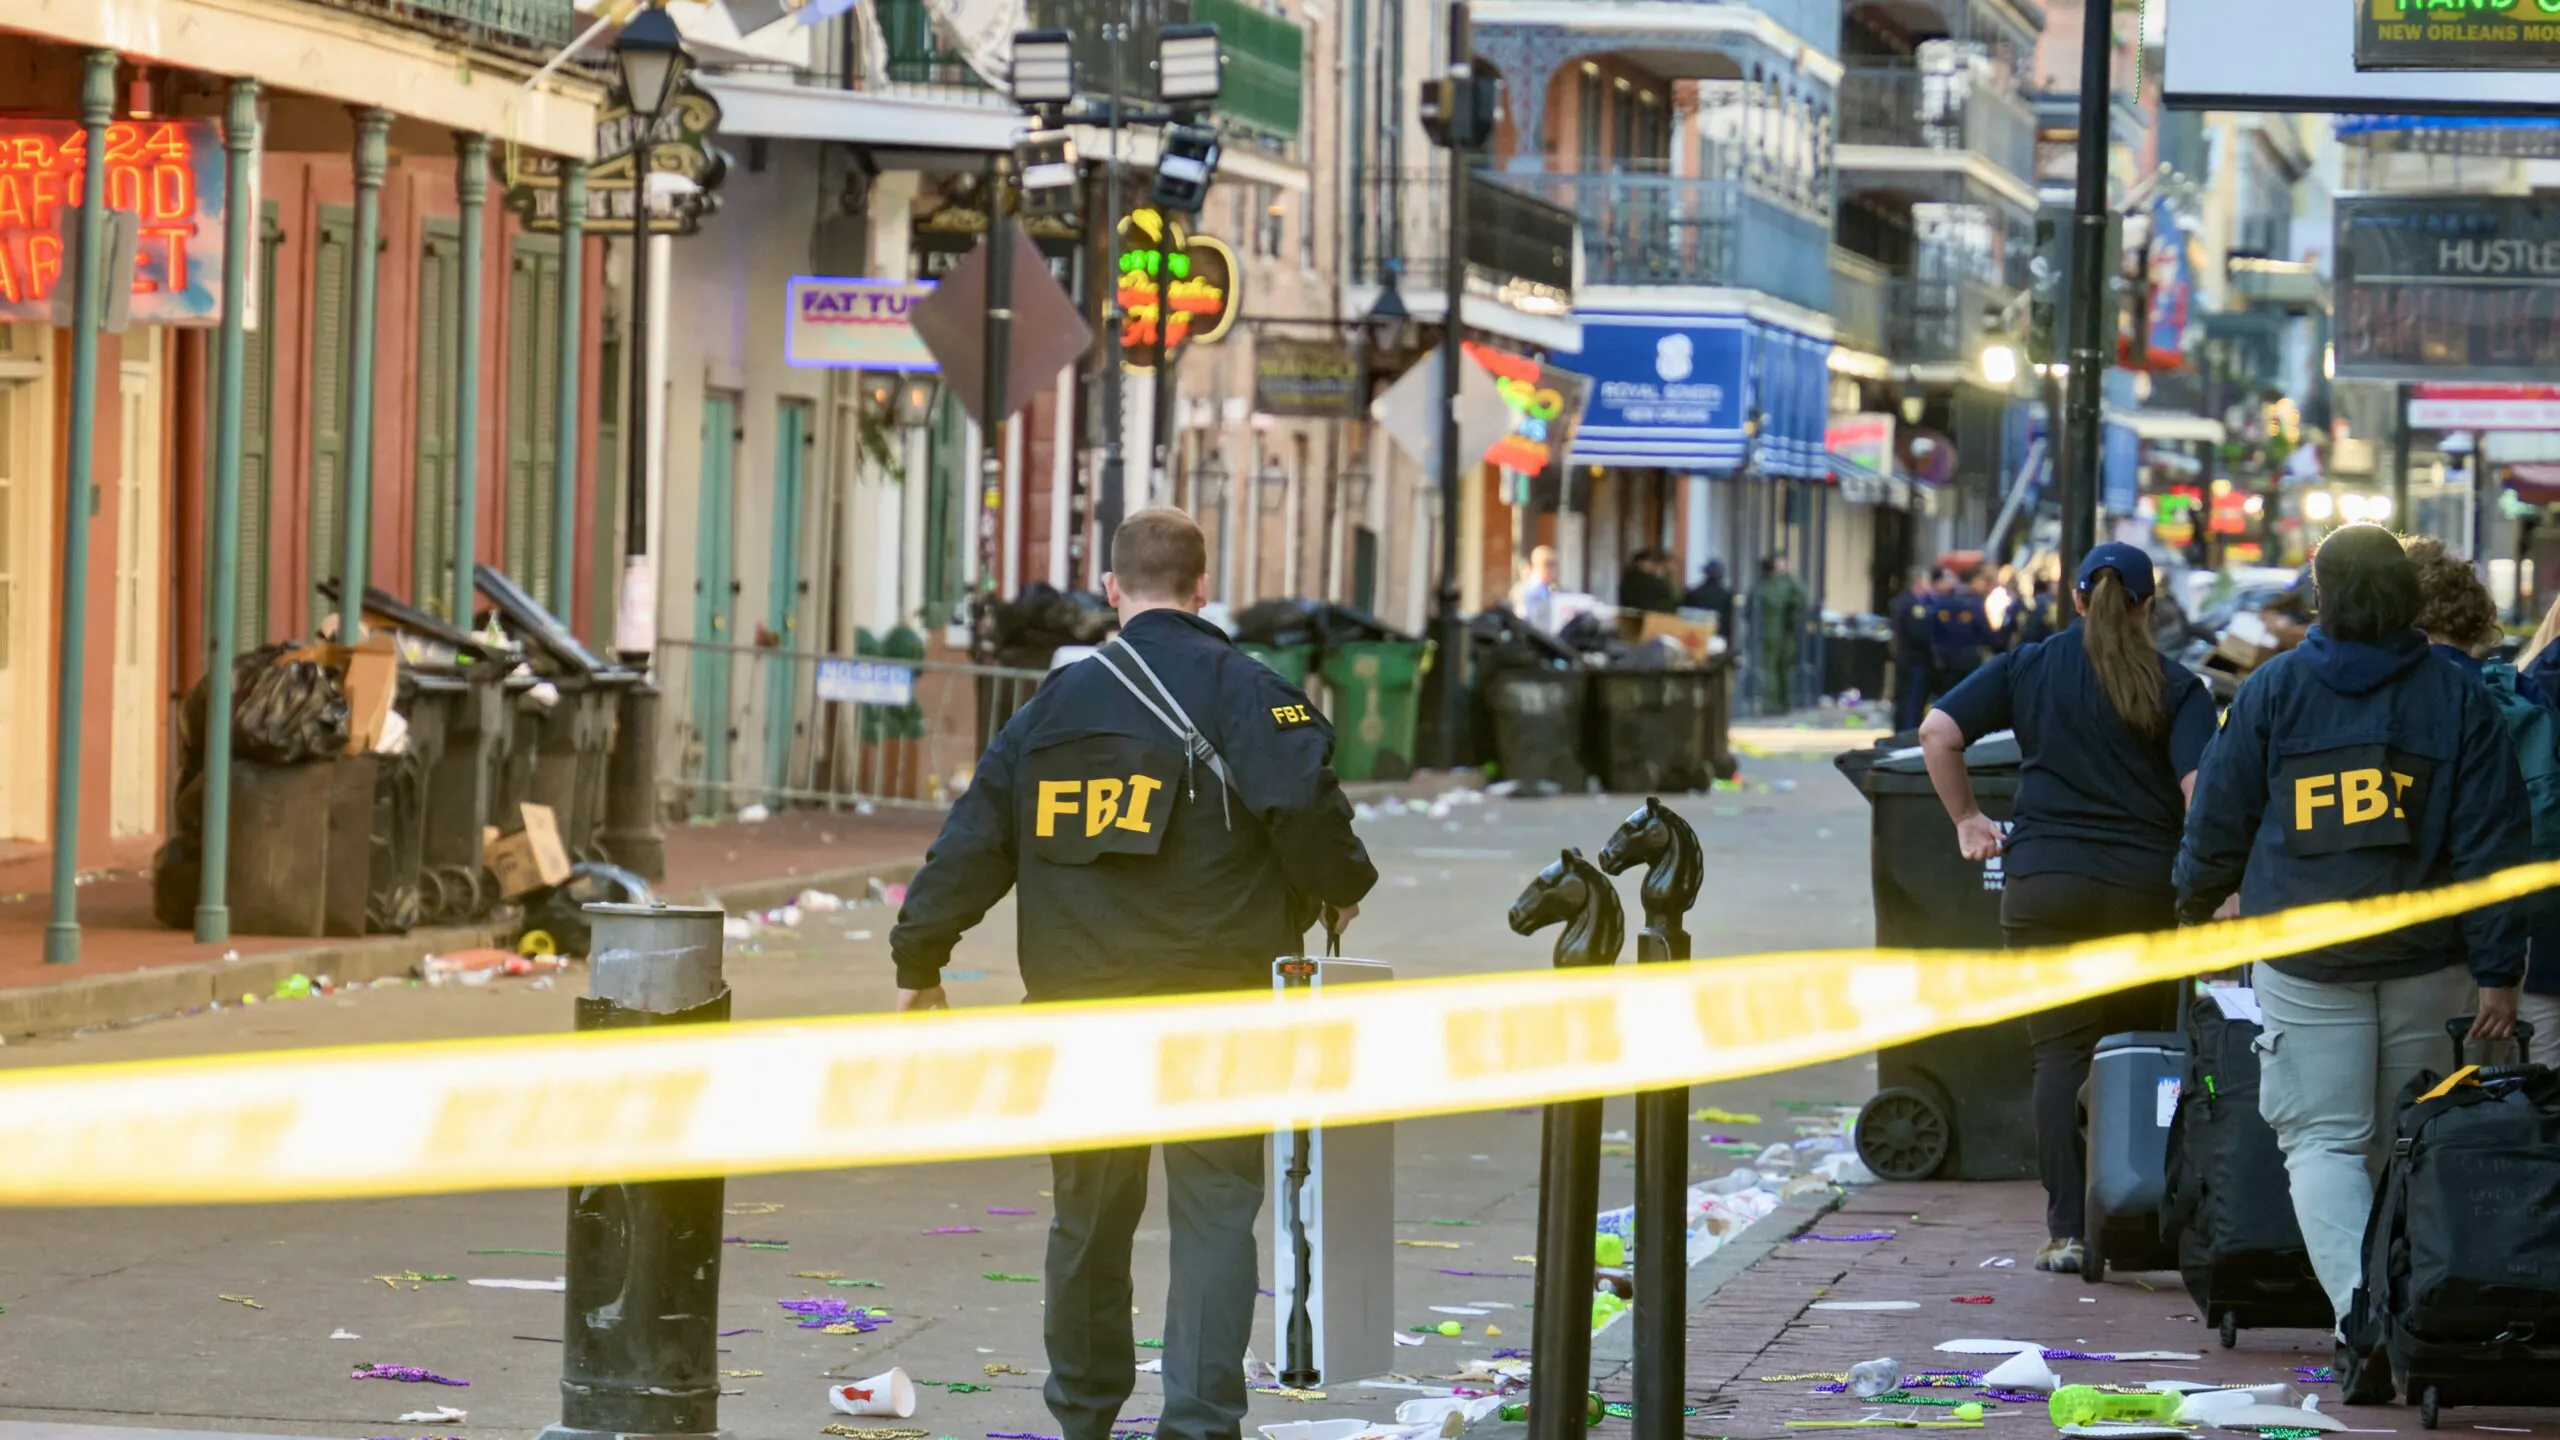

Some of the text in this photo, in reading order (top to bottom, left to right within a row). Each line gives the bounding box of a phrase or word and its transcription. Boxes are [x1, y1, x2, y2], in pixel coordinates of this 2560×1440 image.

[2378, 24, 2423, 41] NEW
[2427, 25, 2518, 41] ORLEANS
[802, 292, 857, 312] FAT
[1271, 704, 1311, 724] FBI
[1036, 774, 1162, 837] FBI
